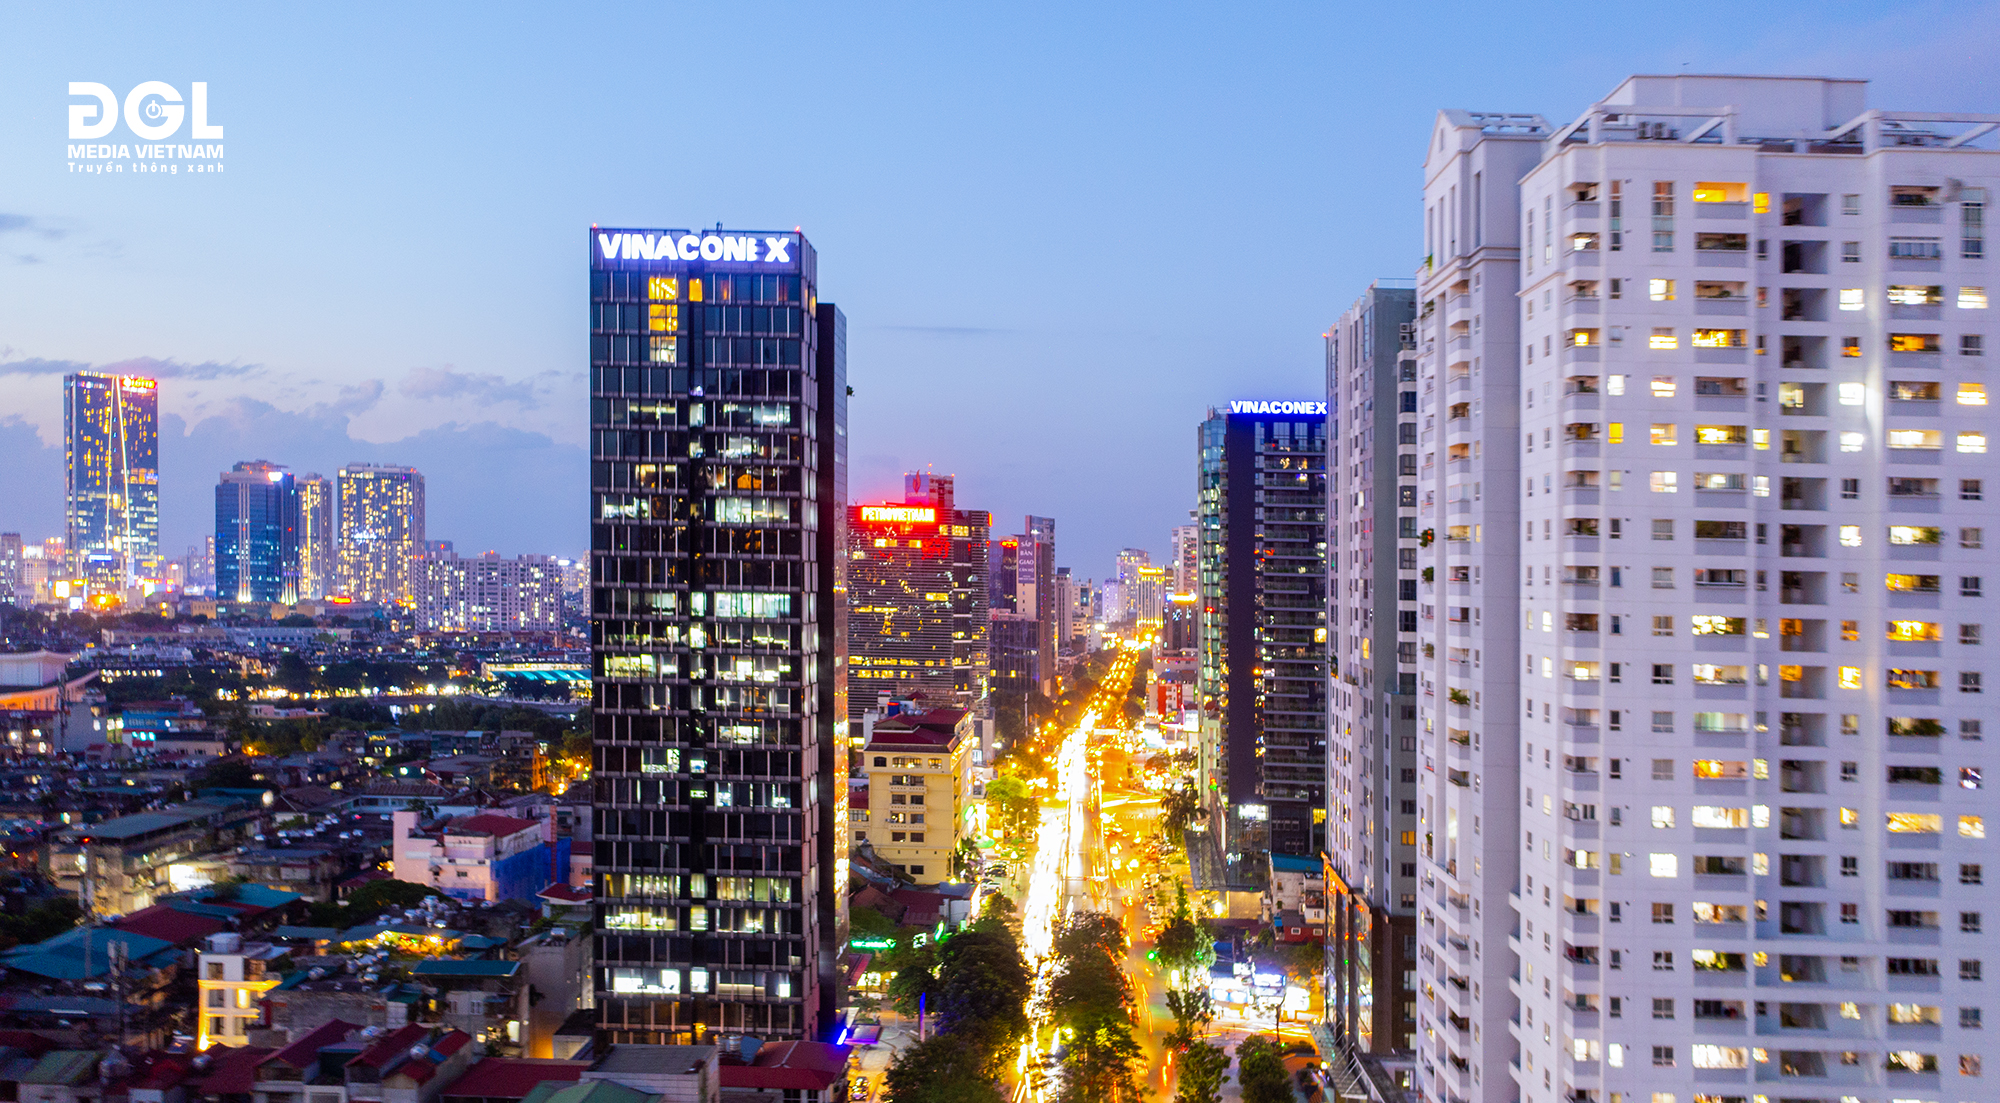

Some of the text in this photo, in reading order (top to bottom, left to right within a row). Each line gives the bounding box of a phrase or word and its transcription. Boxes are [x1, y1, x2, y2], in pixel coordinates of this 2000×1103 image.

[599, 234, 790, 262] VINACONEX
[1231, 401, 1327, 414] VINACONEX
[862, 507, 935, 522] PETROVIETNAM
